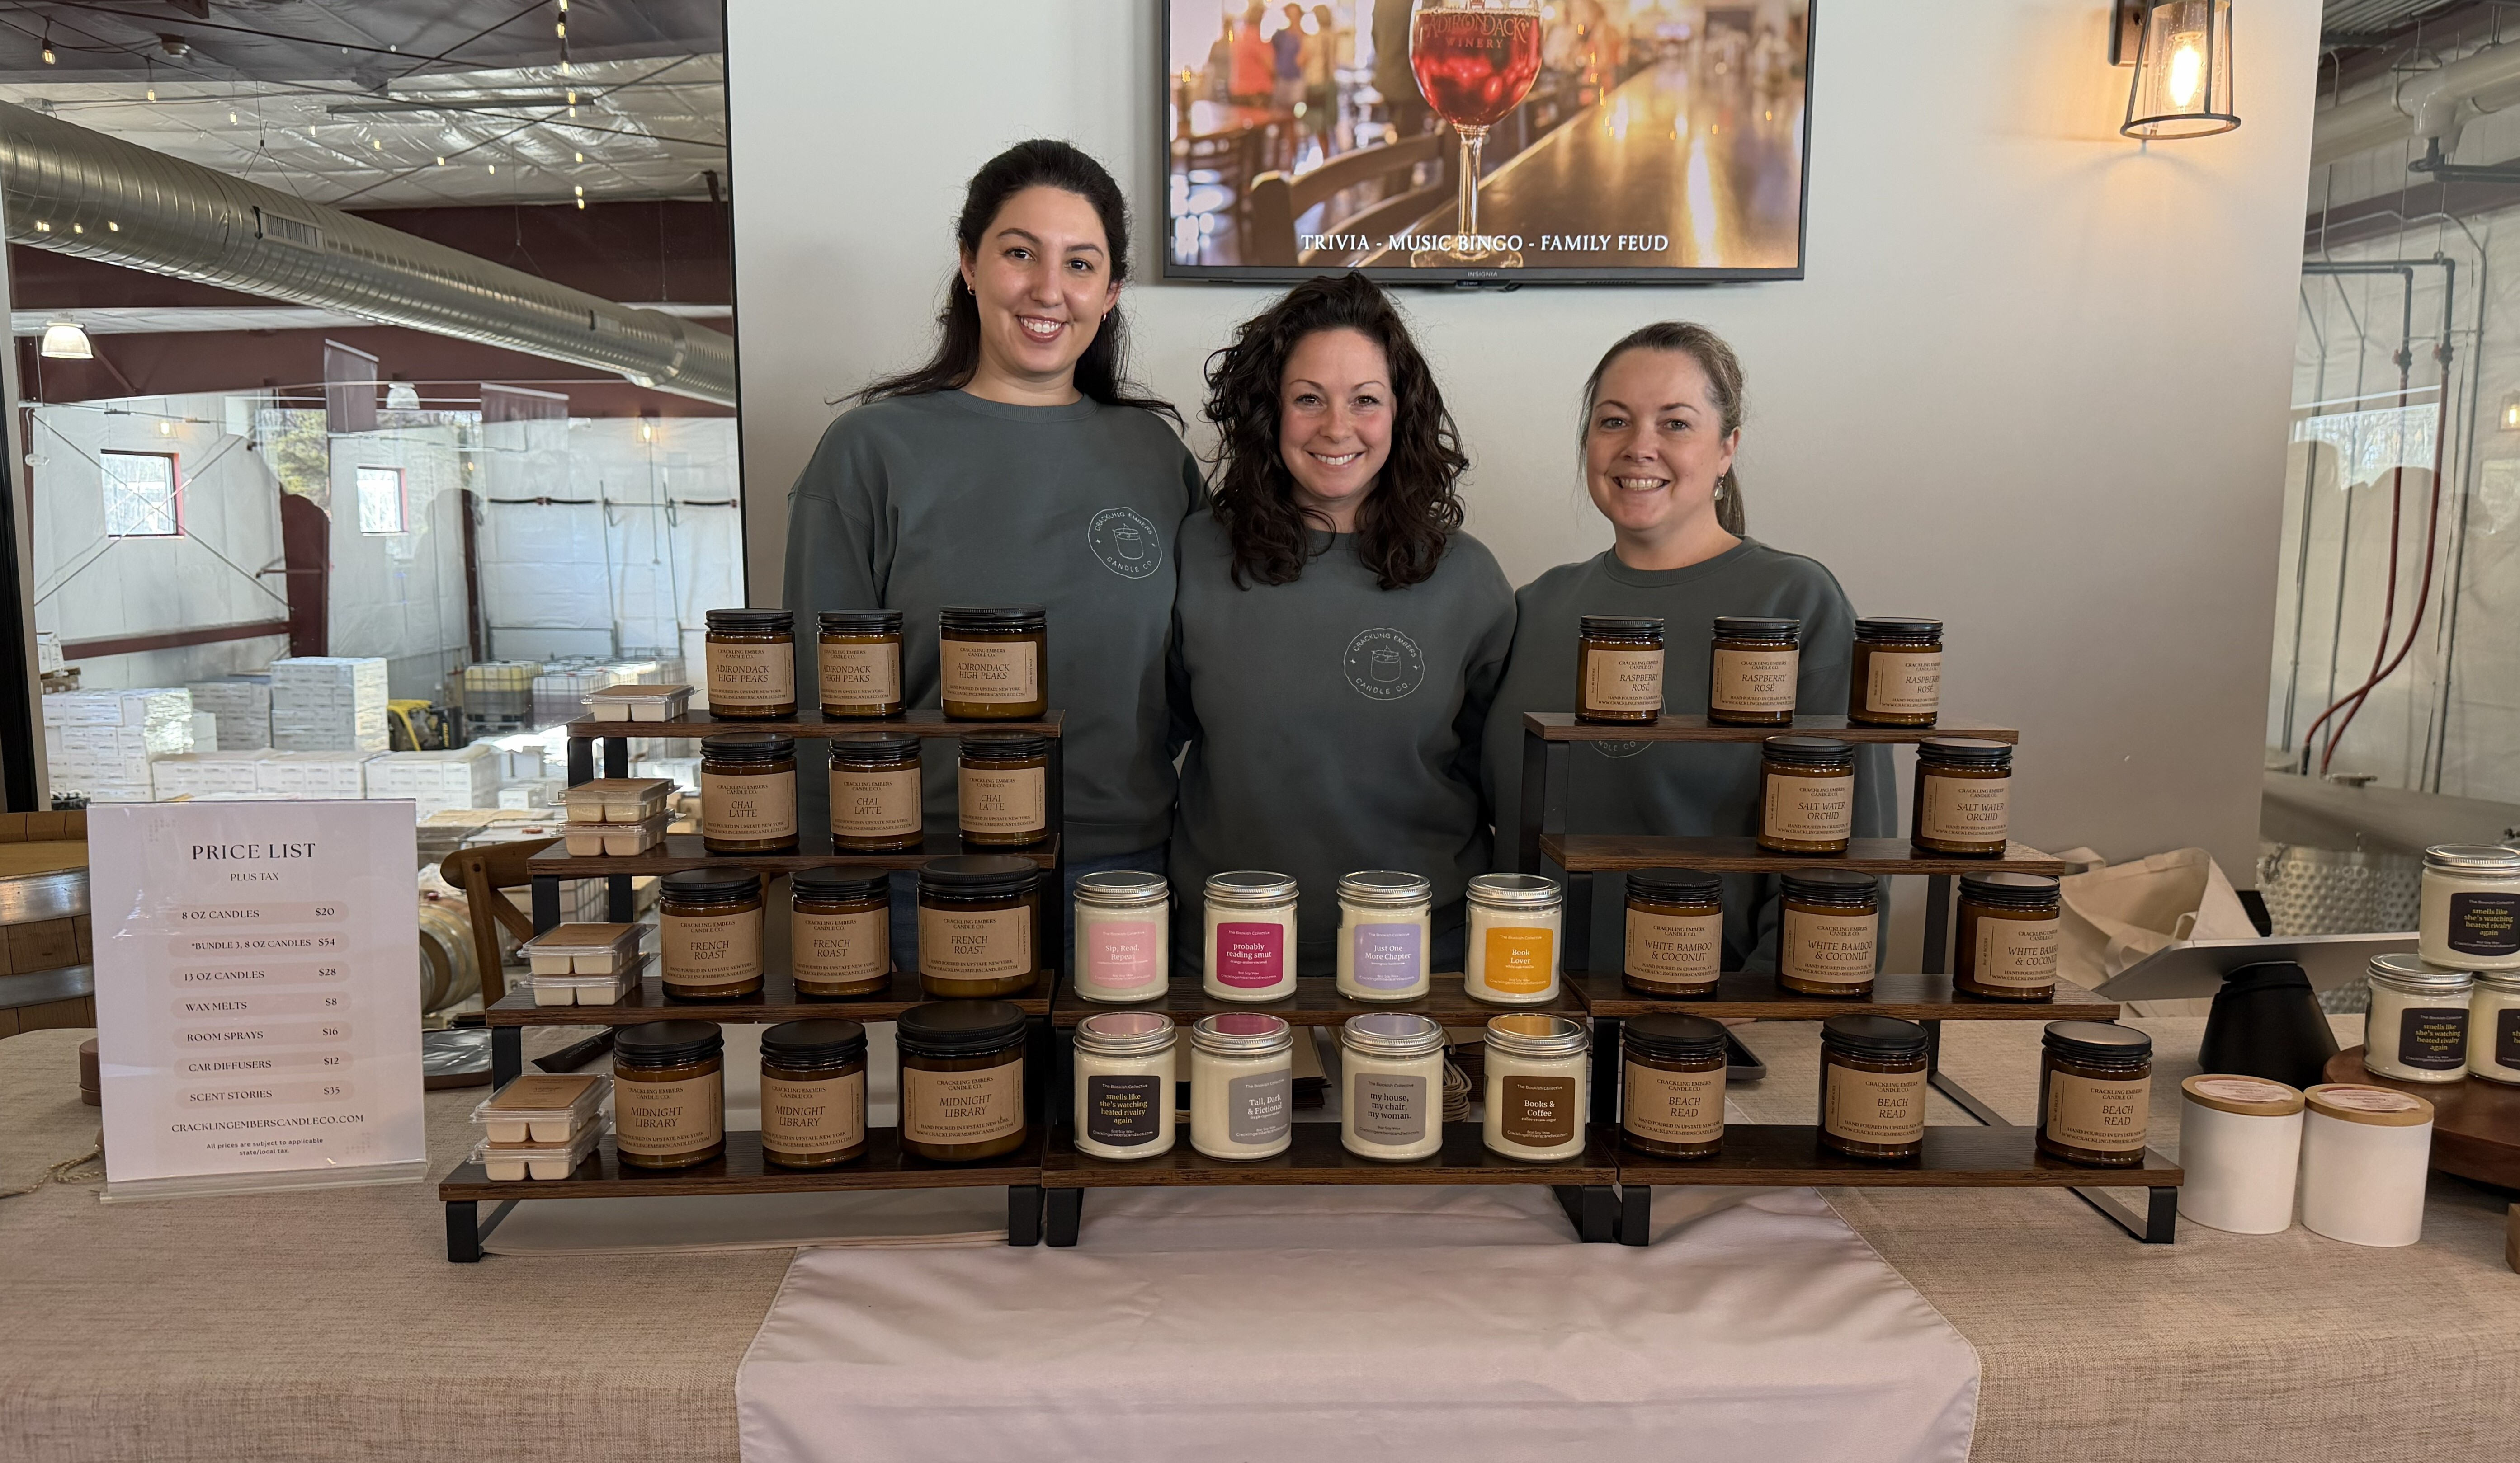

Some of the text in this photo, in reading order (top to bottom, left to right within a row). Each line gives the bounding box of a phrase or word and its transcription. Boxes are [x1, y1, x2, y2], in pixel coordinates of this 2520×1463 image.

[1426, 14, 1528, 43] ADIRONDACK
[1446, 38, 1503, 48] WINERY
[1301, 235, 1669, 251] TRIVIA MUSIC BINGO FAMILY FEUD
[1095, 512, 1152, 535] CRACKLING EMBERS
[1107, 556, 1139, 573] CANDLE
[1353, 633, 1417, 658] CRACKLING EMBERS
[716, 665, 769, 673] ADIRONDACK
[957, 663, 1010, 672] ADIRONDACK
[718, 674, 737, 682] HIGH
[825, 674, 840, 682] HIGH
[959, 671, 977, 679] HIGH
[1356, 678, 1390, 694] CANDLE
[1632, 682, 1650, 692] ROSÉ
[1754, 683, 1775, 692] ROSÉ
[979, 803, 1005, 811] LATTE
[1822, 802, 1845, 810] WATER
[1982, 803, 2004, 811] WATER
[729, 809, 757, 818] LATTE
[1807, 812, 1839, 820] ORCHID
[1967, 813, 1998, 821] ORCHID
[193, 843, 316, 860] PRICE LIST
[231, 872, 279, 881] PLUS TAX
[191, 911, 206, 919] OZ
[209, 910, 259, 919] CANDLES
[315, 908, 335, 916] $20
[236, 941, 242, 950] 3,
[268, 939, 311, 947] CANDLES
[318, 938, 335, 946] $54
[691, 940, 729, 950] FRENCH
[814, 939, 850, 948] FRENCH
[951, 936, 988, 944] FRENCH
[954, 946, 986, 954] ROAST
[1105, 945, 1119, 953] Sip,
[1233, 943, 1265, 951] probably
[1645, 940, 1712, 951] WHITE BAMBOO
[1808, 940, 1872, 951] WHITE BAMBOO
[694, 950, 726, 960] ROAST
[817, 949, 847, 957] ROAST
[1227, 951, 1253, 960] reading
[1652, 951, 1707, 961] & COCONUT
[1815, 951, 1868, 961] & COCONUT
[184, 968, 336, 982] 13 OZ CANDLES $28
[185, 998, 337, 1011] WAX MELTS $8
[187, 1028, 338, 1042] ROOM SPRAYS $16
[189, 1057, 339, 1072] CAR DIFFUSERS $12
[190, 1087, 340, 1101] SCENT STORIES $35
[1370, 1093, 1409, 1102] my house,
[939, 1094, 991, 1106] MIDNIGHT
[1249, 1094, 1281, 1106] Tall, Dark
[1524, 1100, 1548, 1108] Books
[1669, 1096, 1701, 1106] BEACH
[1878, 1098, 1908, 1107] BEACH
[775, 1105, 826, 1116] MIDNIGHT
[945, 1106, 987, 1117] LIBRARY
[1255, 1102, 1282, 1115] Fictional
[1372, 1102, 1407, 1111] my chair,
[2102, 1105, 2133, 1115] BEACH
[631, 1107, 683, 1117] MIDNIGHT
[1368, 1111, 1379, 1119] my
[1671, 1108, 1699, 1117] READ
[1879, 1109, 1906, 1118] READ
[171, 1115, 364, 1133] CRACKLINGEMBERSCANDLECO.COM
[636, 1118, 678, 1128] LIBRARY
[779, 1117, 821, 1127] LIBRARY
[2104, 1117, 2131, 1125] READ
